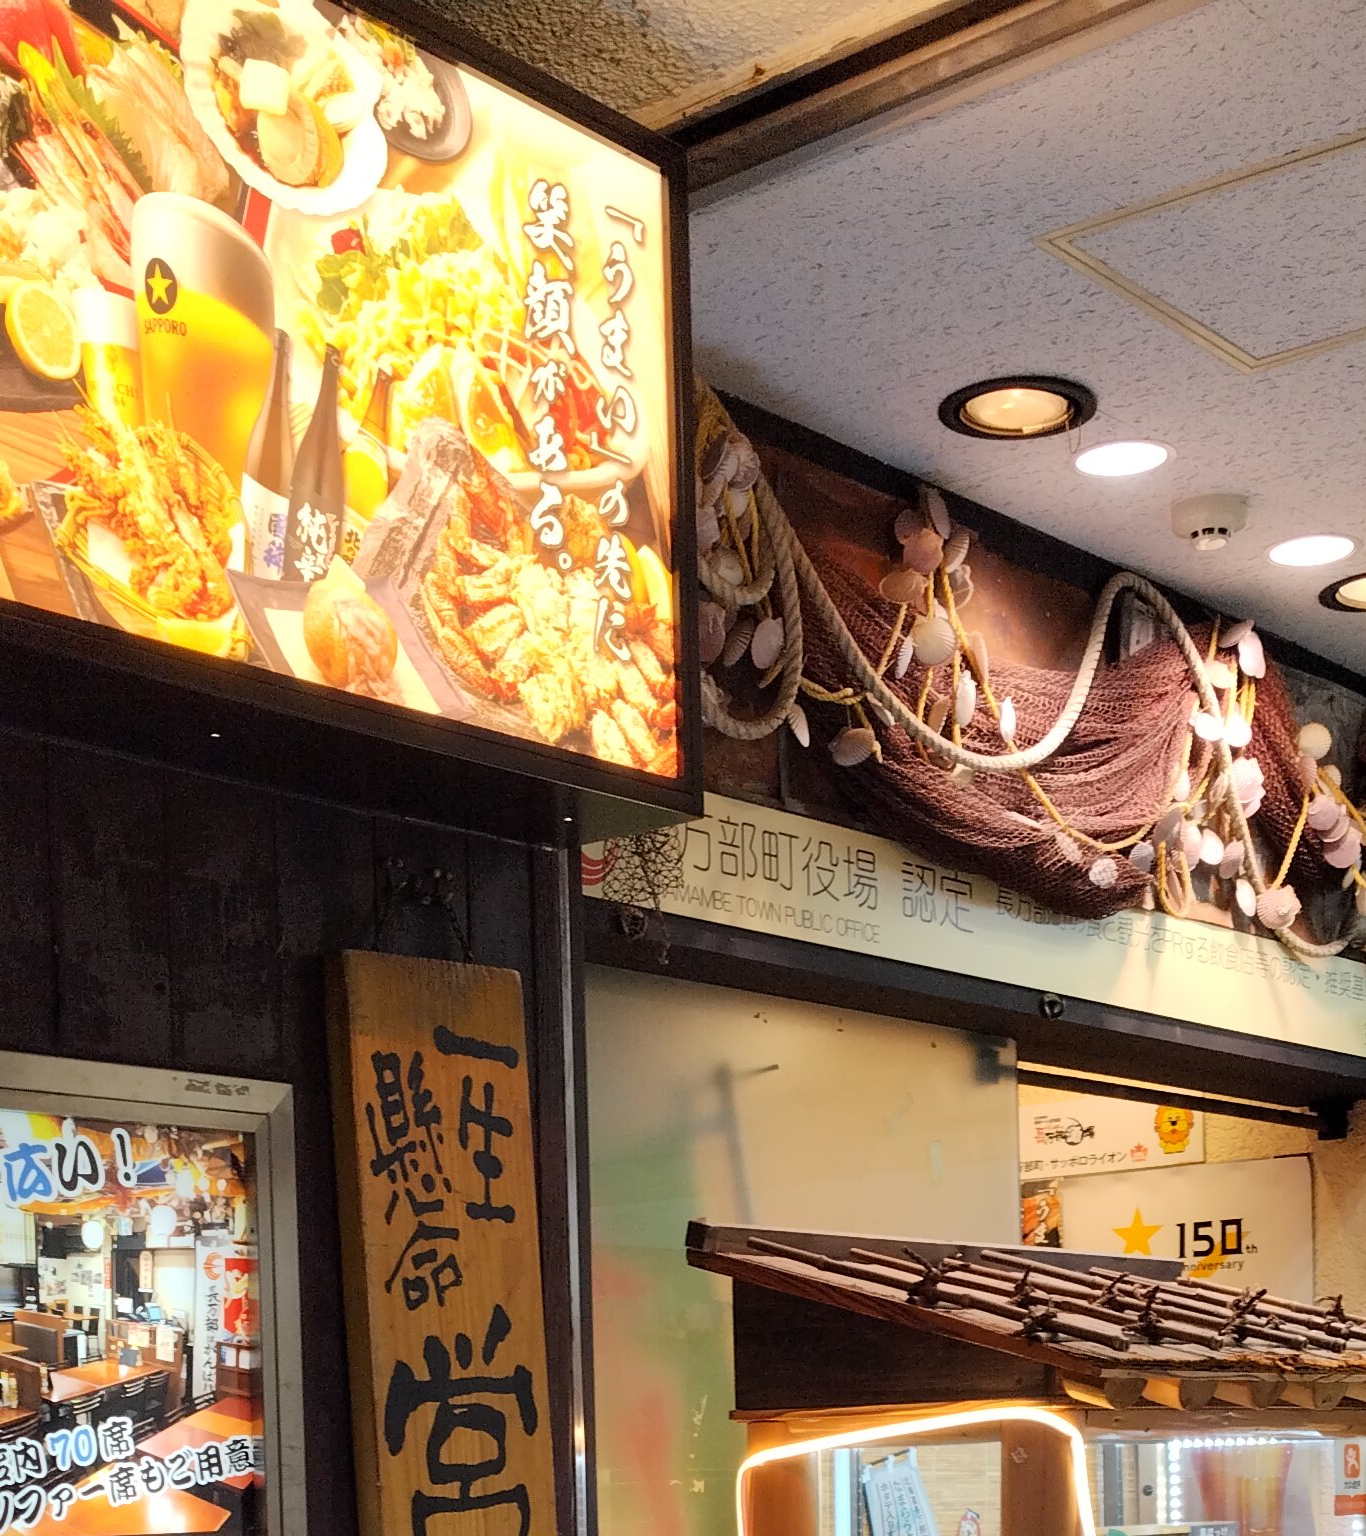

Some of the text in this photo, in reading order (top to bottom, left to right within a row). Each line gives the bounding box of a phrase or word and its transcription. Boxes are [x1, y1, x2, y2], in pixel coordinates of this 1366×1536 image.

[143, 317, 187, 337] SAPPORO
[524, 179, 575, 571] 笑顔がある。
[592, 205, 644, 663] 「うまい」の先に
[737, 894, 782, 923] TOWN
[785, 906, 833, 934] PUBLIC
[836, 917, 881, 944] OFFICE
[901, 860, 974, 934] 認定
[1182, 1259, 1245, 1273] nniversary
